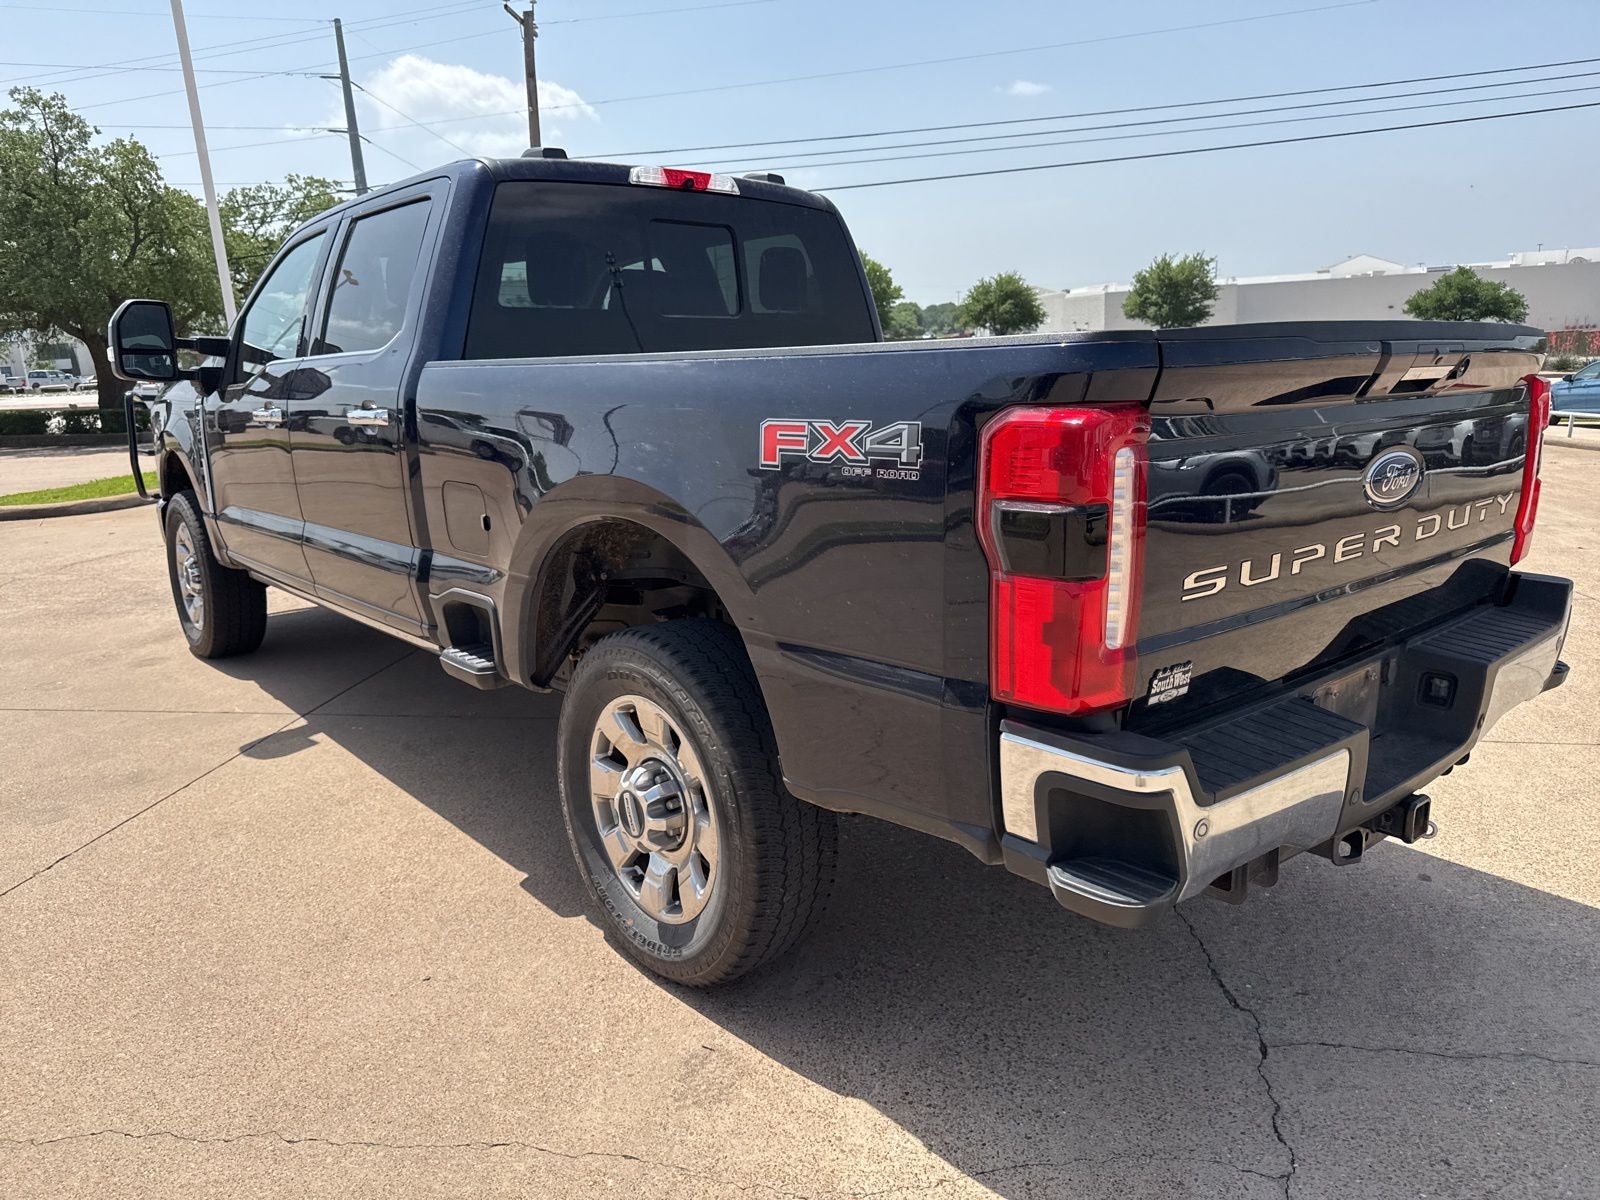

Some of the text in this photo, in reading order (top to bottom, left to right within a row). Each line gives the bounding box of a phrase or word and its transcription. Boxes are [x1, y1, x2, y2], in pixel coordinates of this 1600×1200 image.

[759, 418, 923, 470] FX4
[841, 466, 919, 480] OFF ROAD
[1382, 463, 1412, 492] Ford
[1181, 490, 1515, 601] SUPER DUTY
